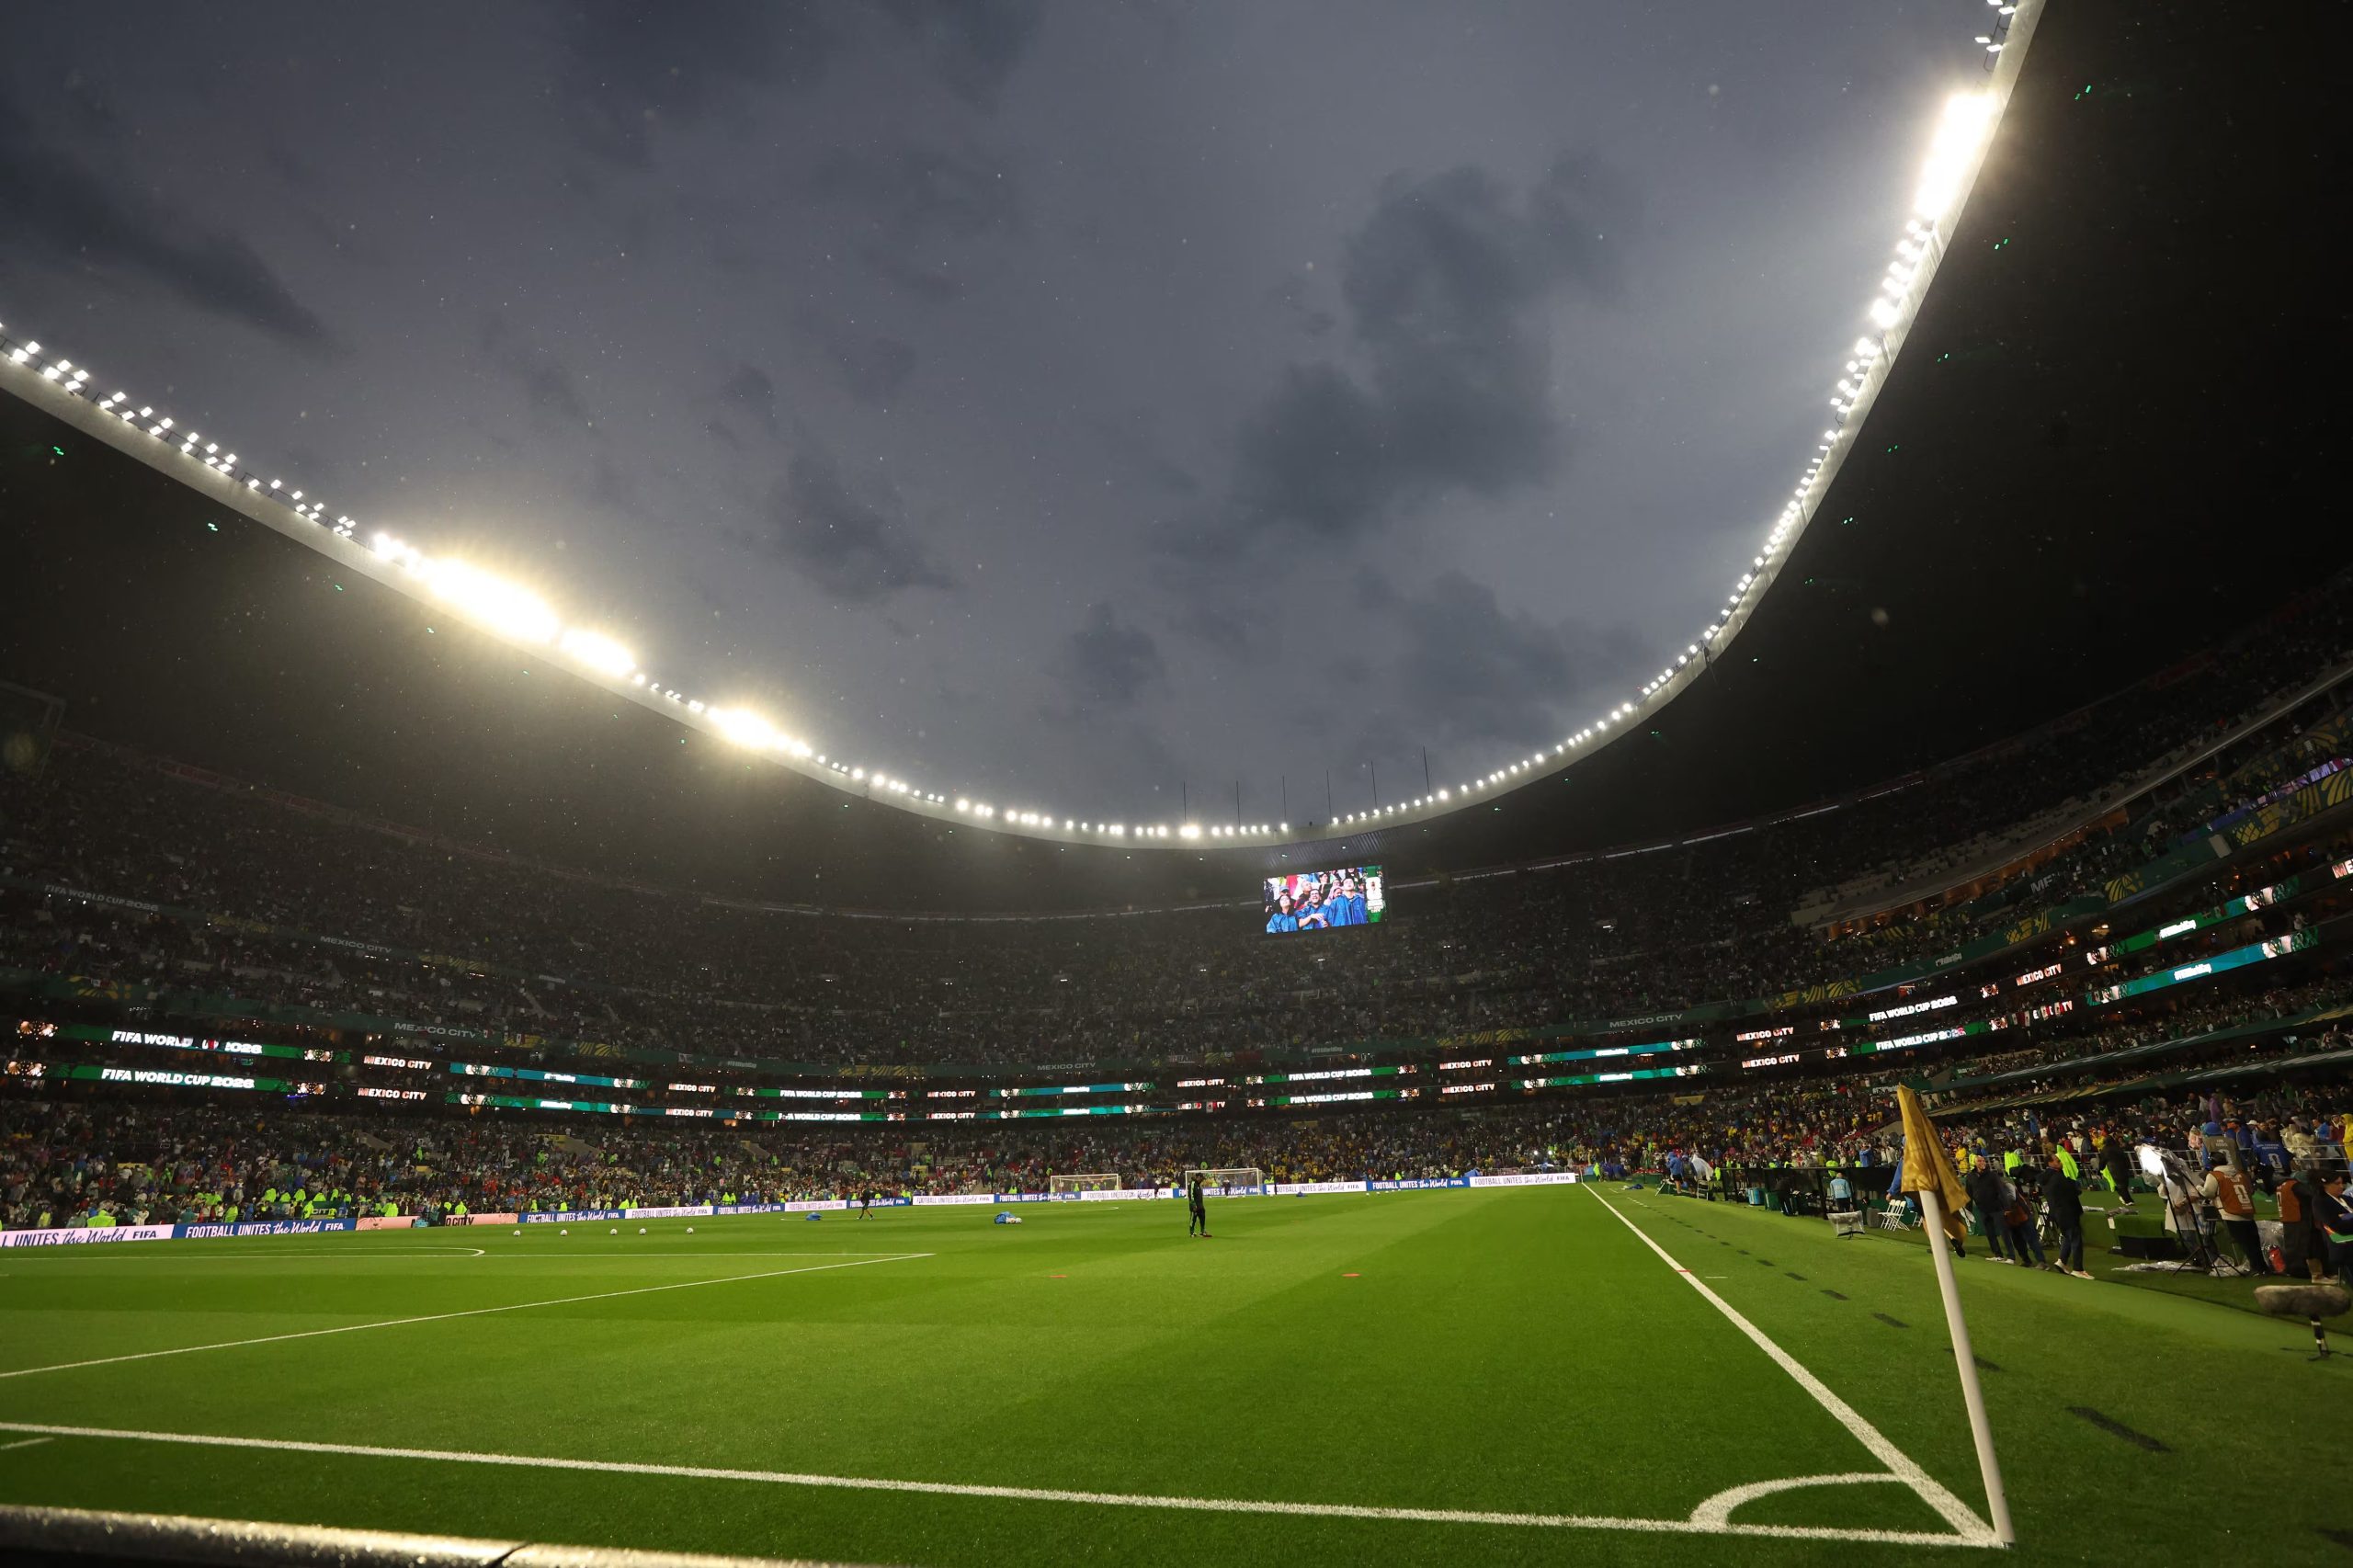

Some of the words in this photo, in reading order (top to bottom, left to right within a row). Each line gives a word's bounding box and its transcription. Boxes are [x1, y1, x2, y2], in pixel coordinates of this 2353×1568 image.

[45, 884, 67, 895] FIFA
[69, 889, 105, 902] WORLD
[106, 896, 125, 906] CUP
[125, 901, 159, 912] 2026
[320, 936, 364, 949] MEXICO
[367, 944, 392, 953] CITY
[2016, 970, 2044, 986] MEXICO
[2044, 963, 2062, 978] CITY
[1869, 1011, 1888, 1022] FIFA
[1886, 1006, 1915, 1018] WORLD
[1915, 1002, 1930, 1012] CUP
[1610, 1017, 1654, 1028] MEXICO
[1656, 1013, 1683, 1023] CITY
[111, 1030, 142, 1043] FIFA
[448, 1028, 476, 1039] CITY
[1736, 1029, 1772, 1041] MEXICO
[1875, 1040, 1894, 1051] FIFA
[1893, 1035, 1923, 1048] WORLD
[1923, 1032, 1938, 1042] CUP
[364, 1056, 405, 1067] MEXICO
[407, 1061, 432, 1070] CITY
[1439, 1062, 1471, 1070] MEXICO
[1742, 1057, 1778, 1068] MEXICO
[1779, 1054, 1800, 1064] CITY
[101, 1068, 132, 1081] FIFA
[134, 1070, 183, 1085] WORLD
[184, 1074, 211, 1086] CUP
[210, 1076, 256, 1088] 2026
[1304, 1072, 1329, 1080] WORLD
[1331, 1070, 1346, 1078] CUP
[358, 1088, 400, 1099] MEXICO
[402, 1091, 426, 1100] CITY
[669, 1084, 697, 1092] MEXICO
[1442, 1085, 1474, 1094] MEXICO
[1475, 1083, 1495, 1091] CITY
[1305, 1094, 1331, 1103] WORLD
[1372, 1182, 1399, 1190] FOOTBALL
[1399, 1180, 1417, 1189] UNITES
[1419, 1179, 1430, 1188] the
[1430, 1178, 1448, 1187] World
[1474, 1176, 1502, 1186] FOOTBALL
[1503, 1176, 1523, 1185] UNITES
[1524, 1176, 1535, 1184] the
[1535, 1175, 1553, 1184] World
[1299, 1184, 1316, 1192] UNITES
[556, 1213, 575, 1222] UNITES
[576, 1211, 586, 1221] the
[632, 1210, 654, 1218] FOOTBALL
[656, 1209, 672, 1217] UNITES
[186, 1224, 235, 1239] FOOTBALL
[237, 1223, 272, 1235] UNITES
[273, 1221, 290, 1234] the
[290, 1221, 322, 1233] World
[325, 1222, 344, 1231] FIFA
[14, 1233, 60, 1247] UNITES
[63, 1230, 85, 1244] the
[86, 1228, 128, 1244] World
[132, 1230, 156, 1239] FIFA
